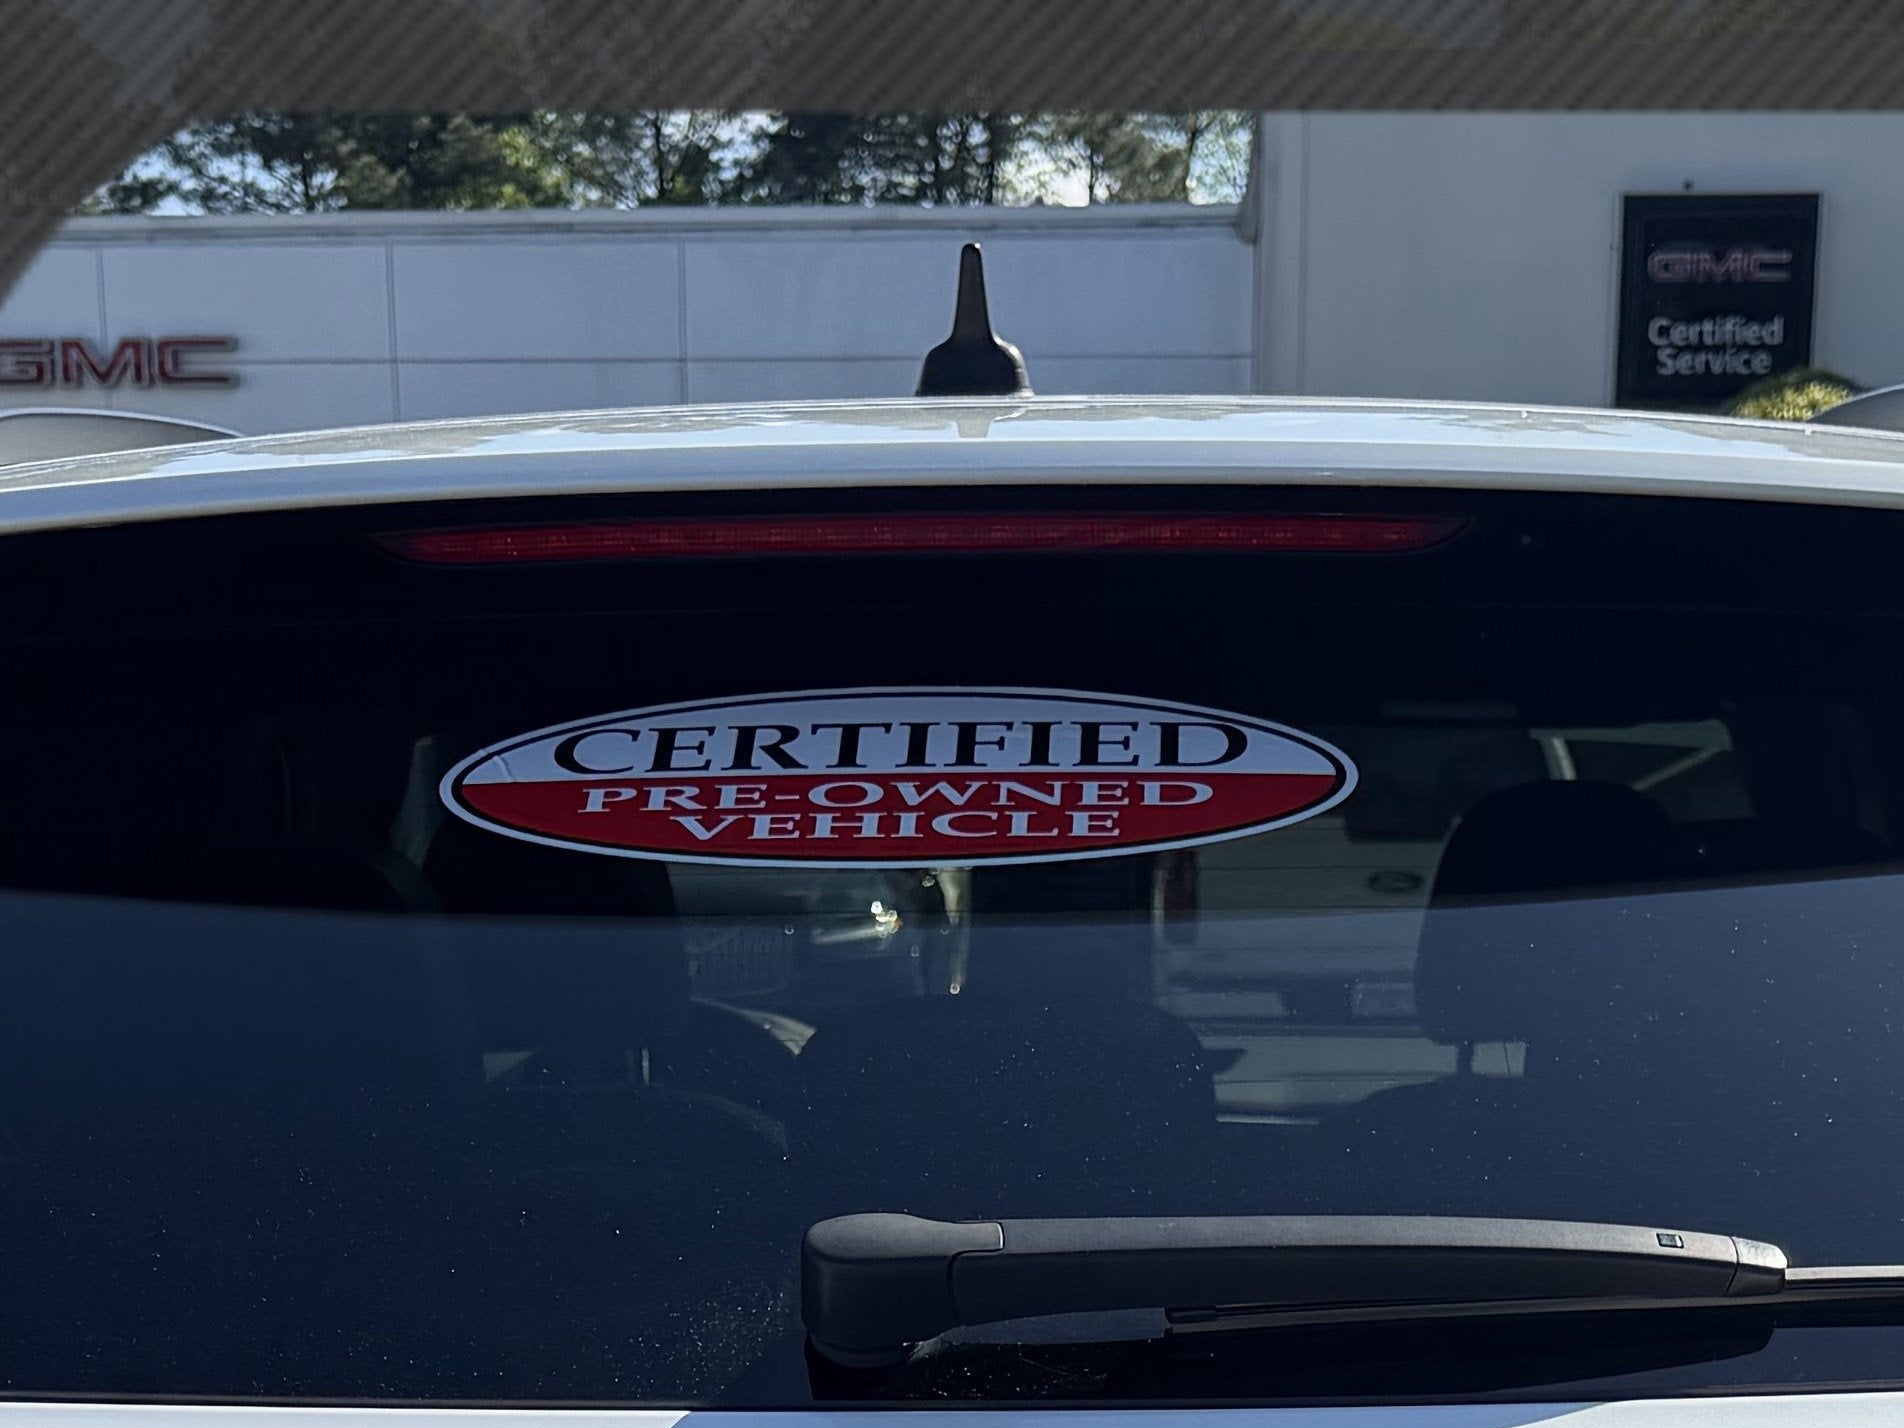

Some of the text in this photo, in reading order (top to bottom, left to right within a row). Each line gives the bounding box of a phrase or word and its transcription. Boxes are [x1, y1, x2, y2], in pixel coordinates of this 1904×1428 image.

[1647, 251, 1793, 283] GMC
[1648, 315, 1784, 346] Certified
[1656, 346, 1773, 375] Service
[552, 719, 1249, 774] CERTIFIED
[580, 779, 1215, 814] PRE-OWNED
[669, 809, 1121, 841] VEHICLE
